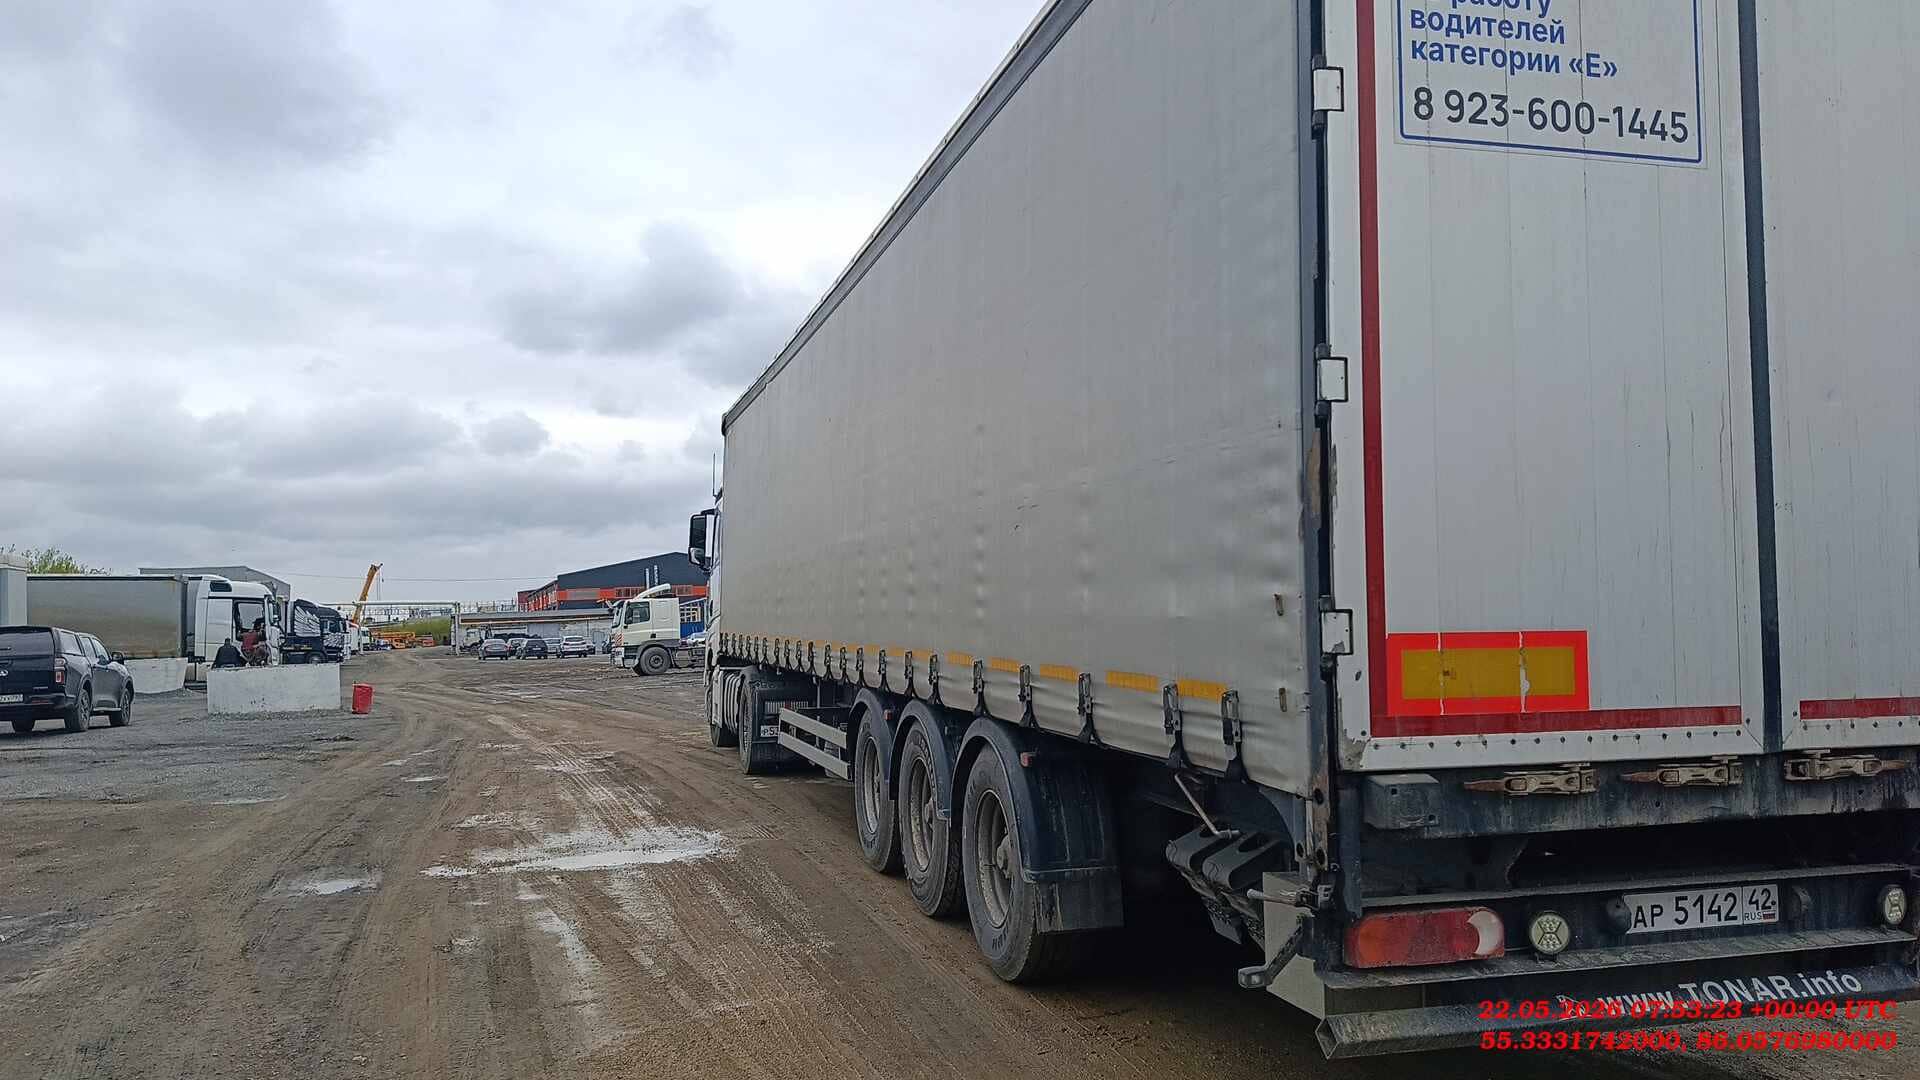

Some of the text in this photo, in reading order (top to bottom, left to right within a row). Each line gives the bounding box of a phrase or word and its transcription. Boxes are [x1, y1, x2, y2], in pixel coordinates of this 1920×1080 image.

[1411, 9, 1565, 45] водителей
[1411, 40, 1560, 75] категории
[1414, 87, 1689, 143] 8 923-600-1445
[1674, 892, 1738, 926] 5142
[1748, 888, 1772, 911] 42
[1744, 911, 1763, 921] RUS
